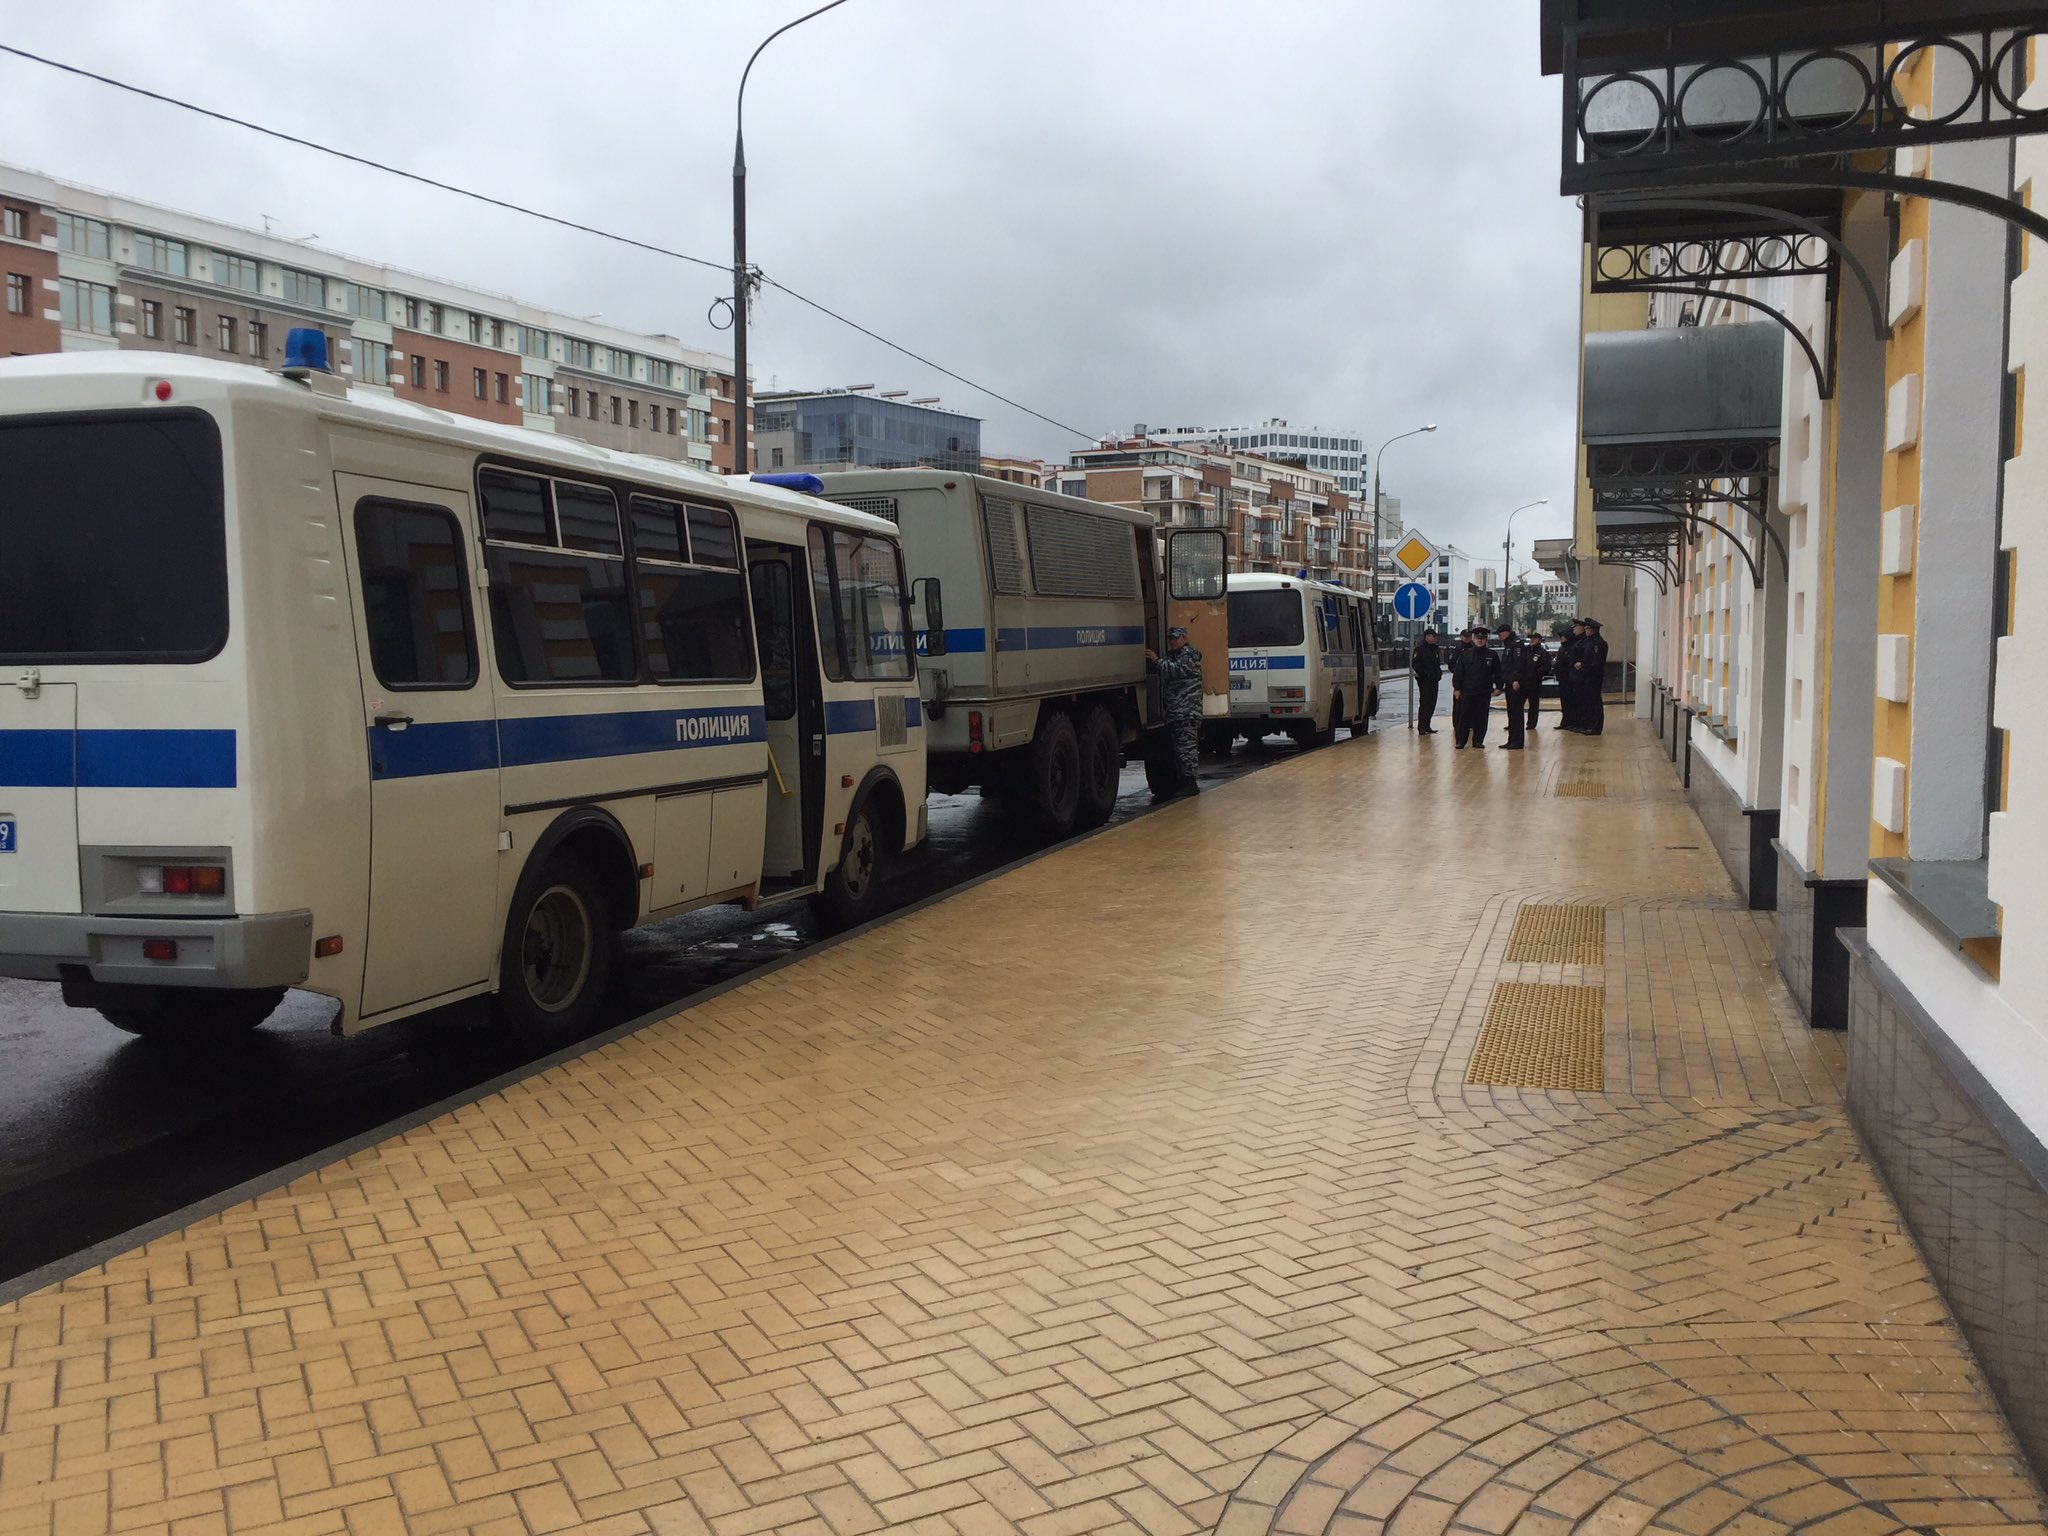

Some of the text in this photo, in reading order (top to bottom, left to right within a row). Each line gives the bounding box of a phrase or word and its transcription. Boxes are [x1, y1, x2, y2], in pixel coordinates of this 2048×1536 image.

[1076, 629, 1105, 647] ПОЛИЦИЯ
[1230, 659, 1267, 670] ИЦИЯ
[675, 714, 750, 741] ПОЛИЦИЯ
